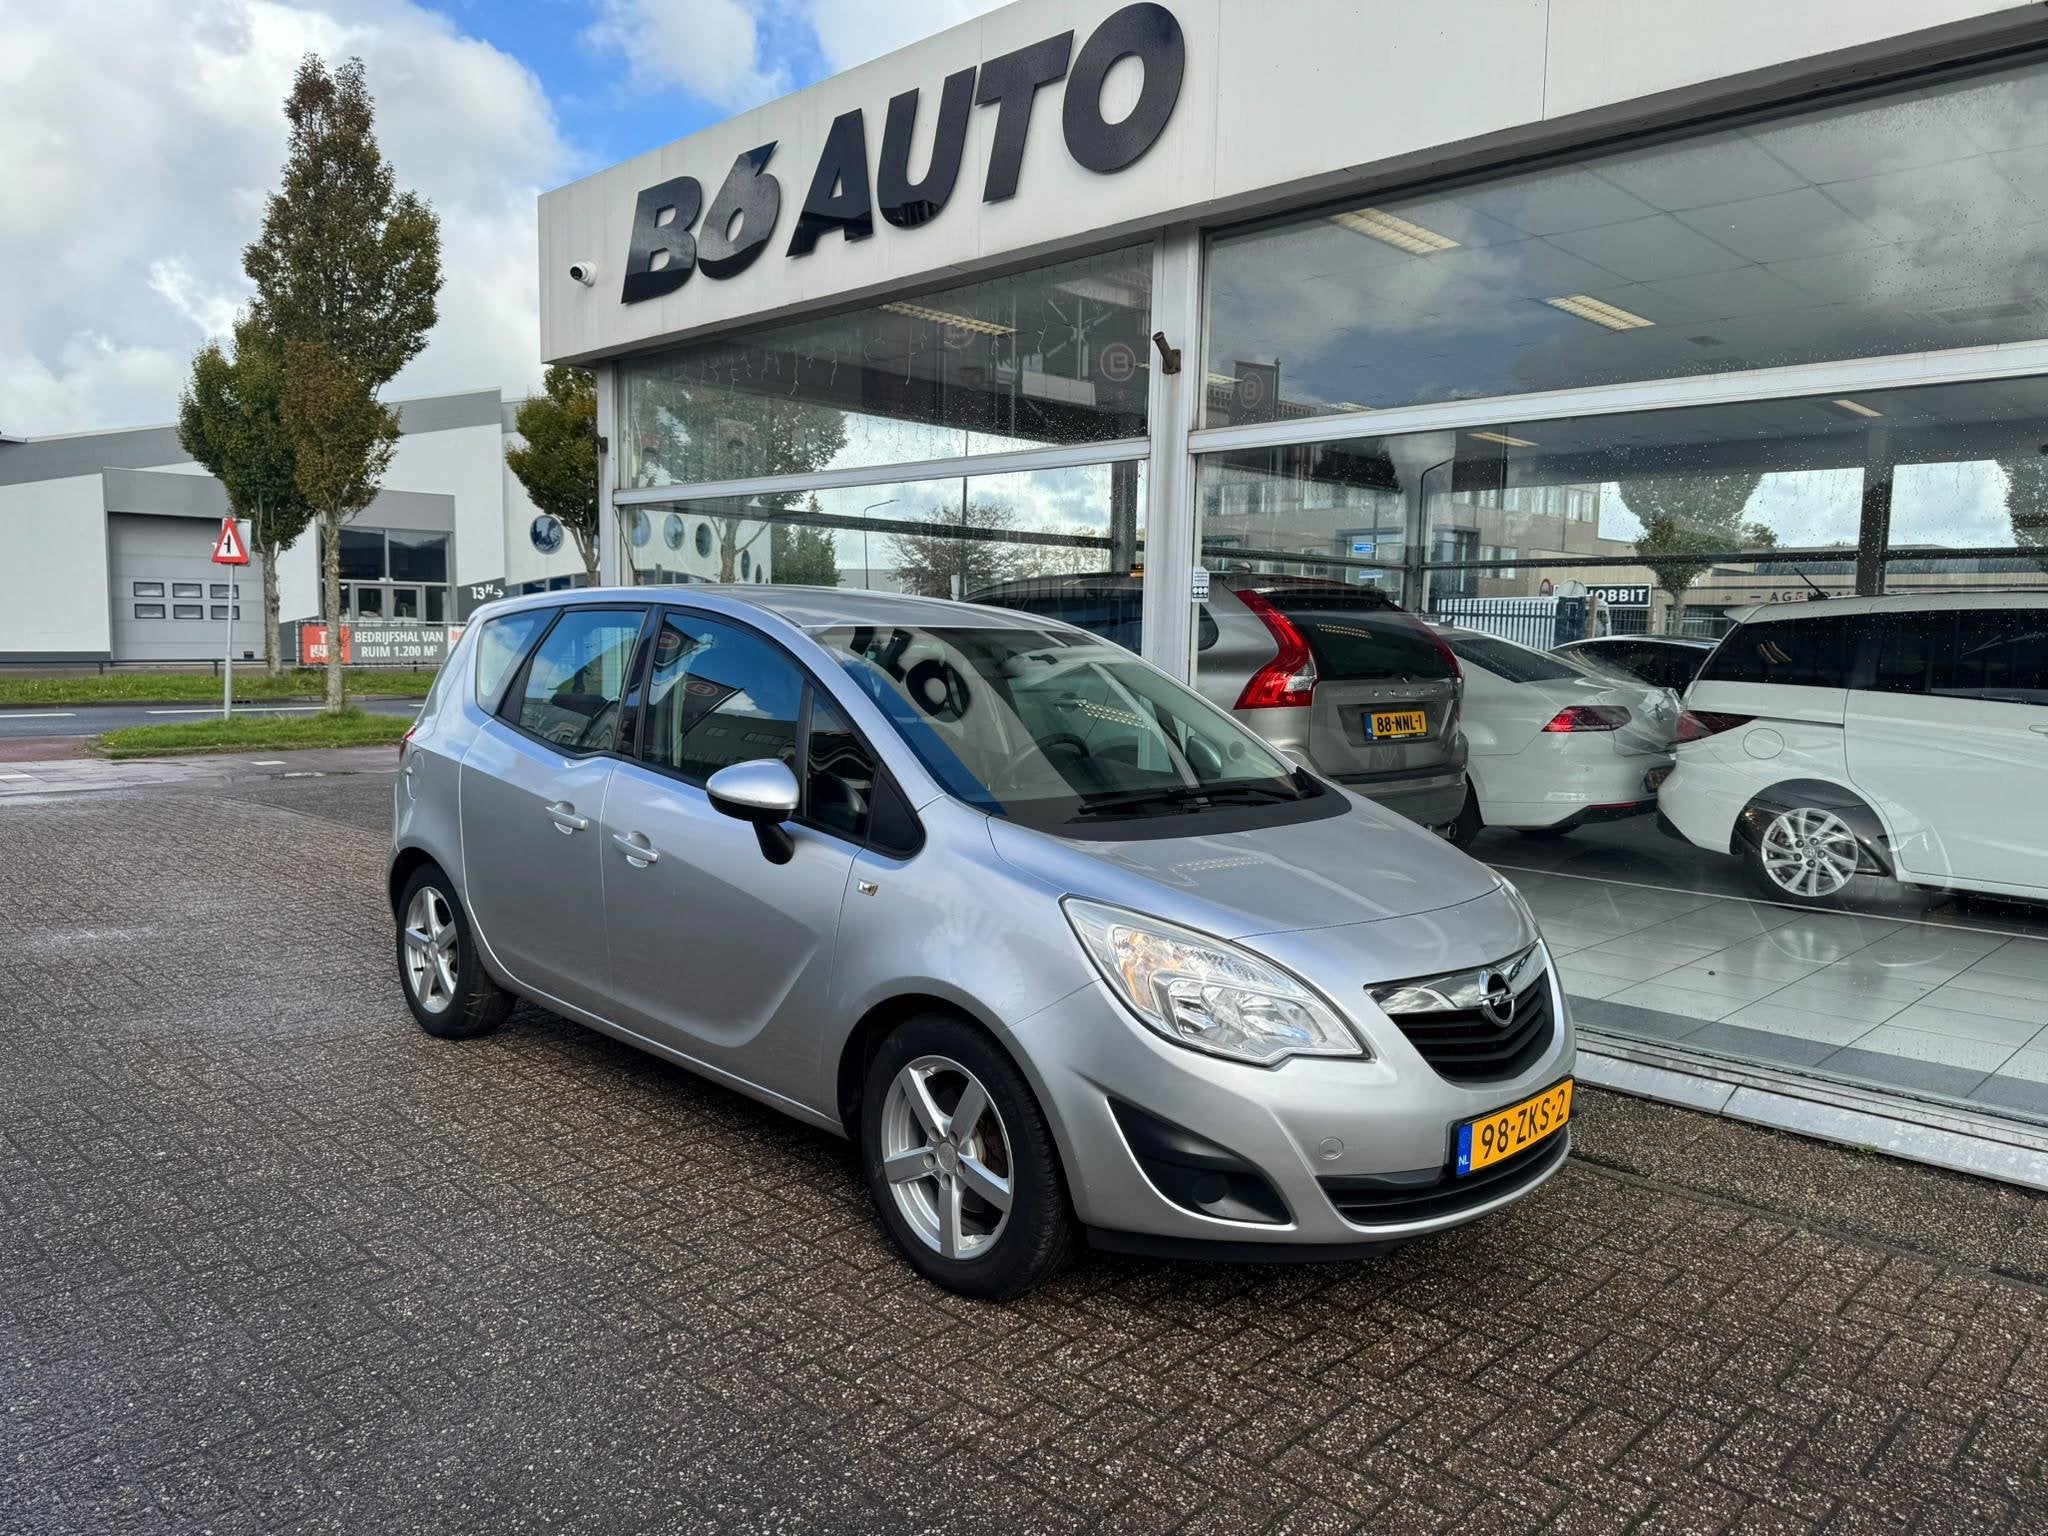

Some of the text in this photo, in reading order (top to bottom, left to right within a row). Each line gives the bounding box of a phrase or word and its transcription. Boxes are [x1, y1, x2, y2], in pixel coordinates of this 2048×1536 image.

[621, 1, 1185, 304] B6 AUTO
[354, 631, 420, 645] BEDRIJFSHAL
[421, 631, 444, 643] VAN
[361, 645, 391, 658] RUIM
[393, 645, 421, 657] 1.200
[1376, 714, 1423, 732] 88-NNL-1
[1481, 1089, 1565, 1160] 98-ZKS-2
[1458, 1154, 1470, 1166] NL
